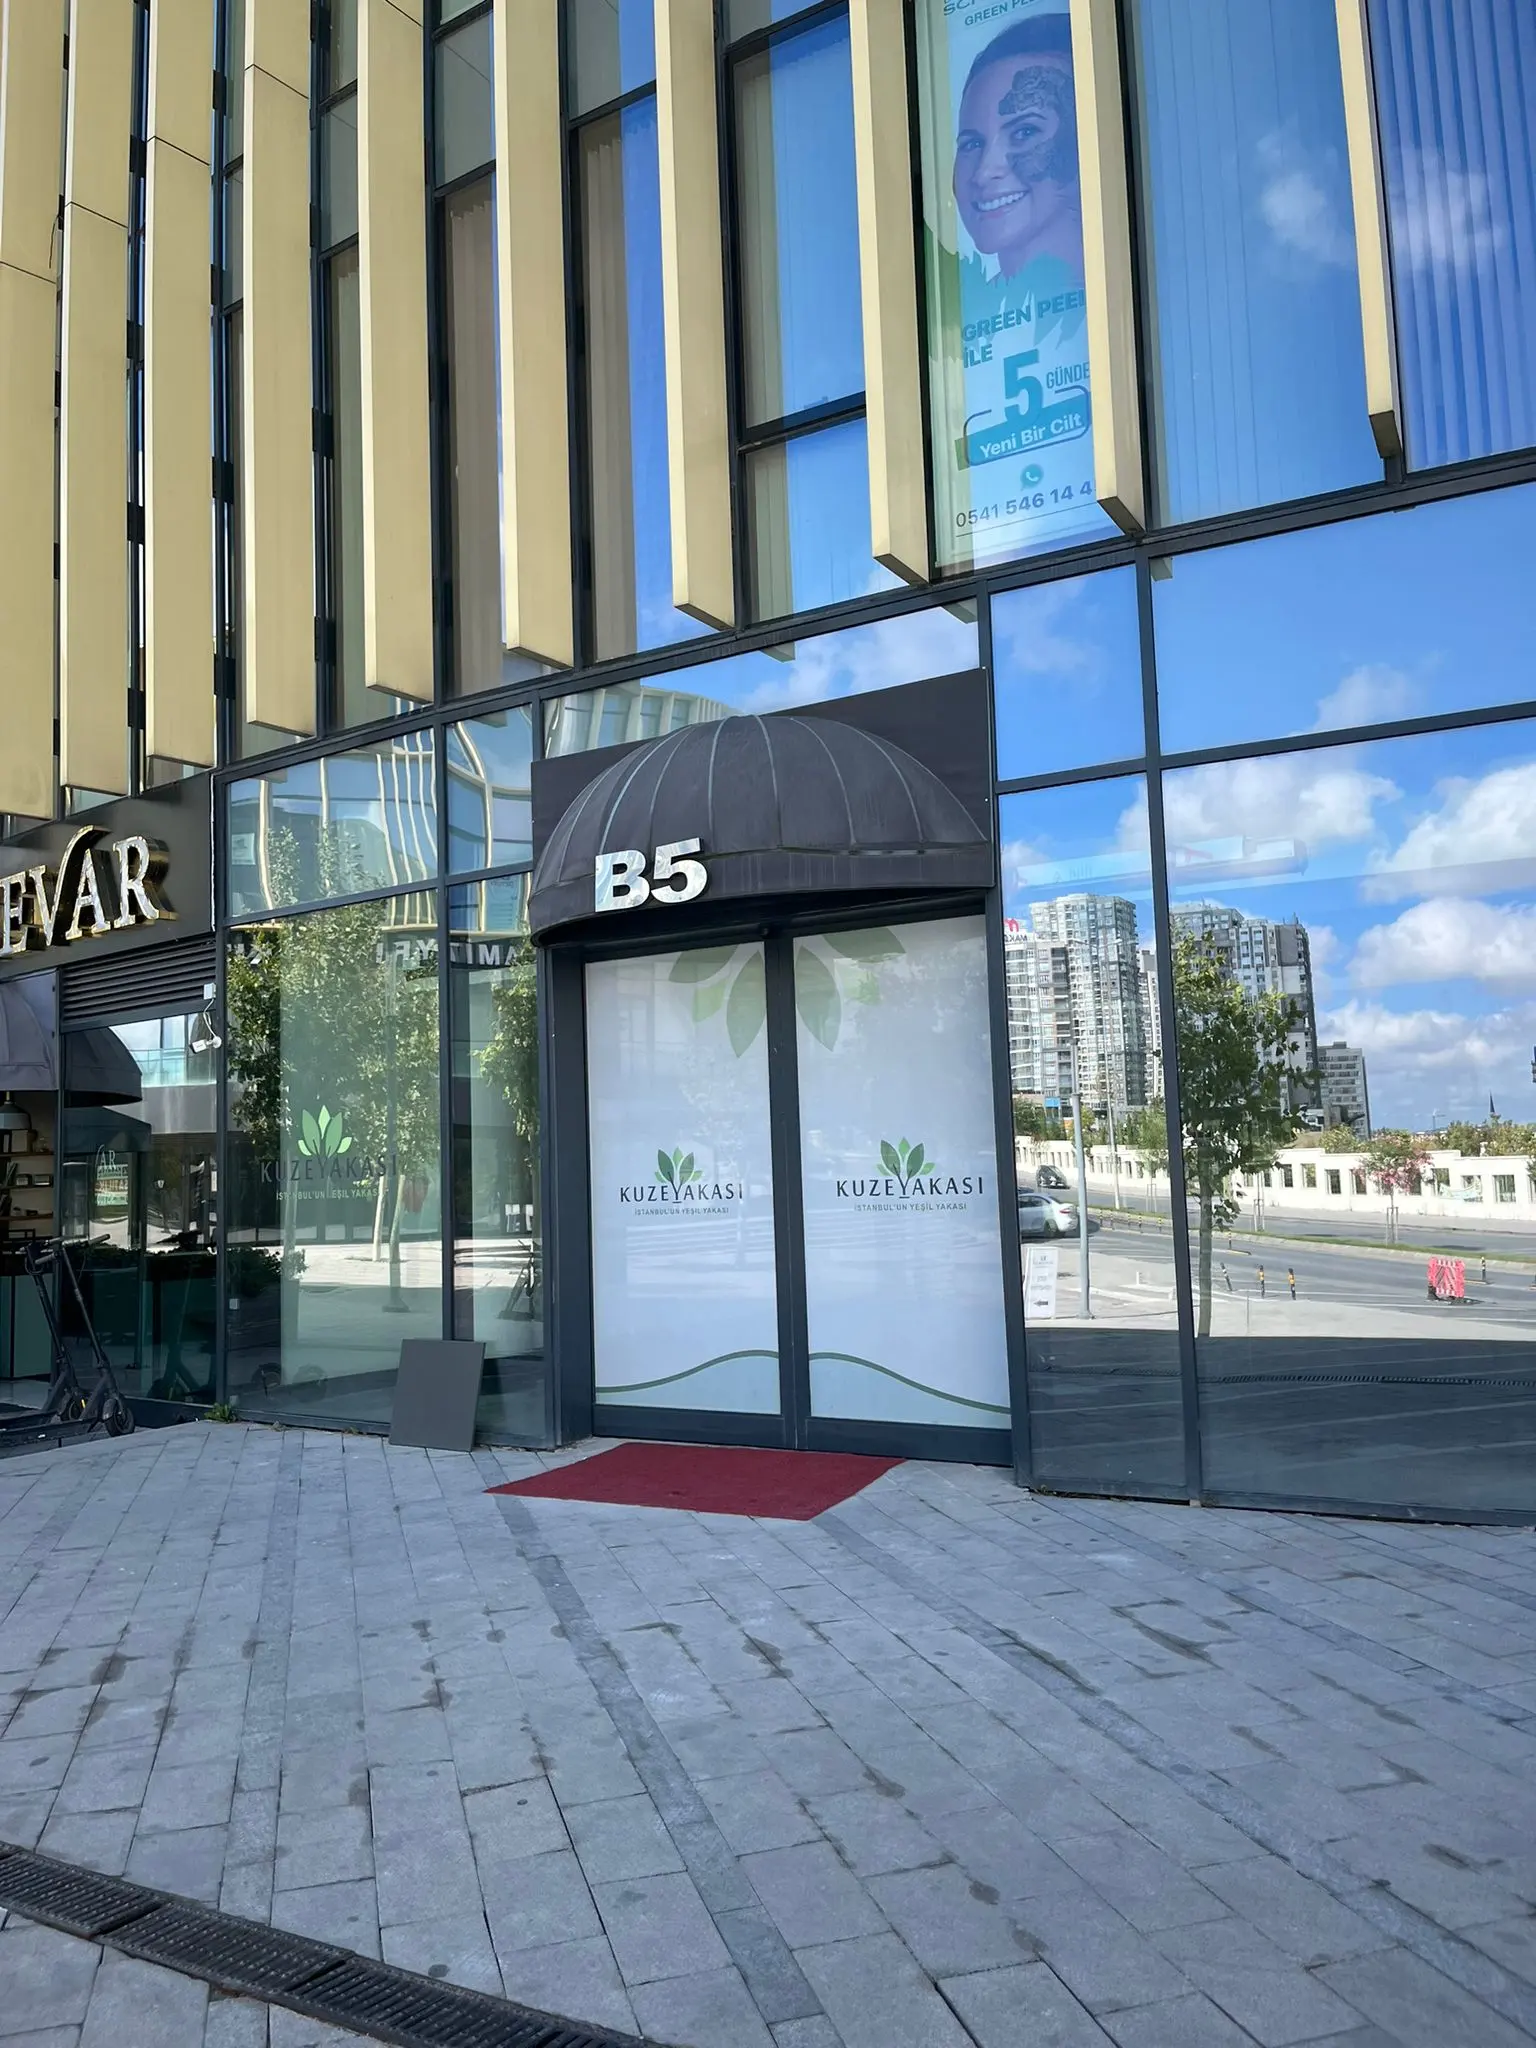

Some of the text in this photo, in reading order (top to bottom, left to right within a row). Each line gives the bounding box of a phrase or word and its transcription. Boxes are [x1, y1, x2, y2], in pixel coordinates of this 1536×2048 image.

[964, 3, 1008, 27] GREEN
[962, 305, 1031, 342] GREEN
[963, 344, 992, 369] İLE
[1003, 348, 1044, 425] 5
[979, 412, 1082, 458] Yeni Bir Cilt
[956, 503, 999, 528] 0541
[1005, 492, 1045, 515] 546
[1050, 485, 1074, 504] 14
[595, 837, 707, 912] B5
[261, 1154, 397, 1184] KUZEYAKASI
[620, 1182, 743, 1203] KUZEYAKASI
[836, 1176, 983, 1199] KUZEYAKASI
[910, 1202, 933, 1212] YEŞİL
[936, 1202, 967, 1210] YAKASI
